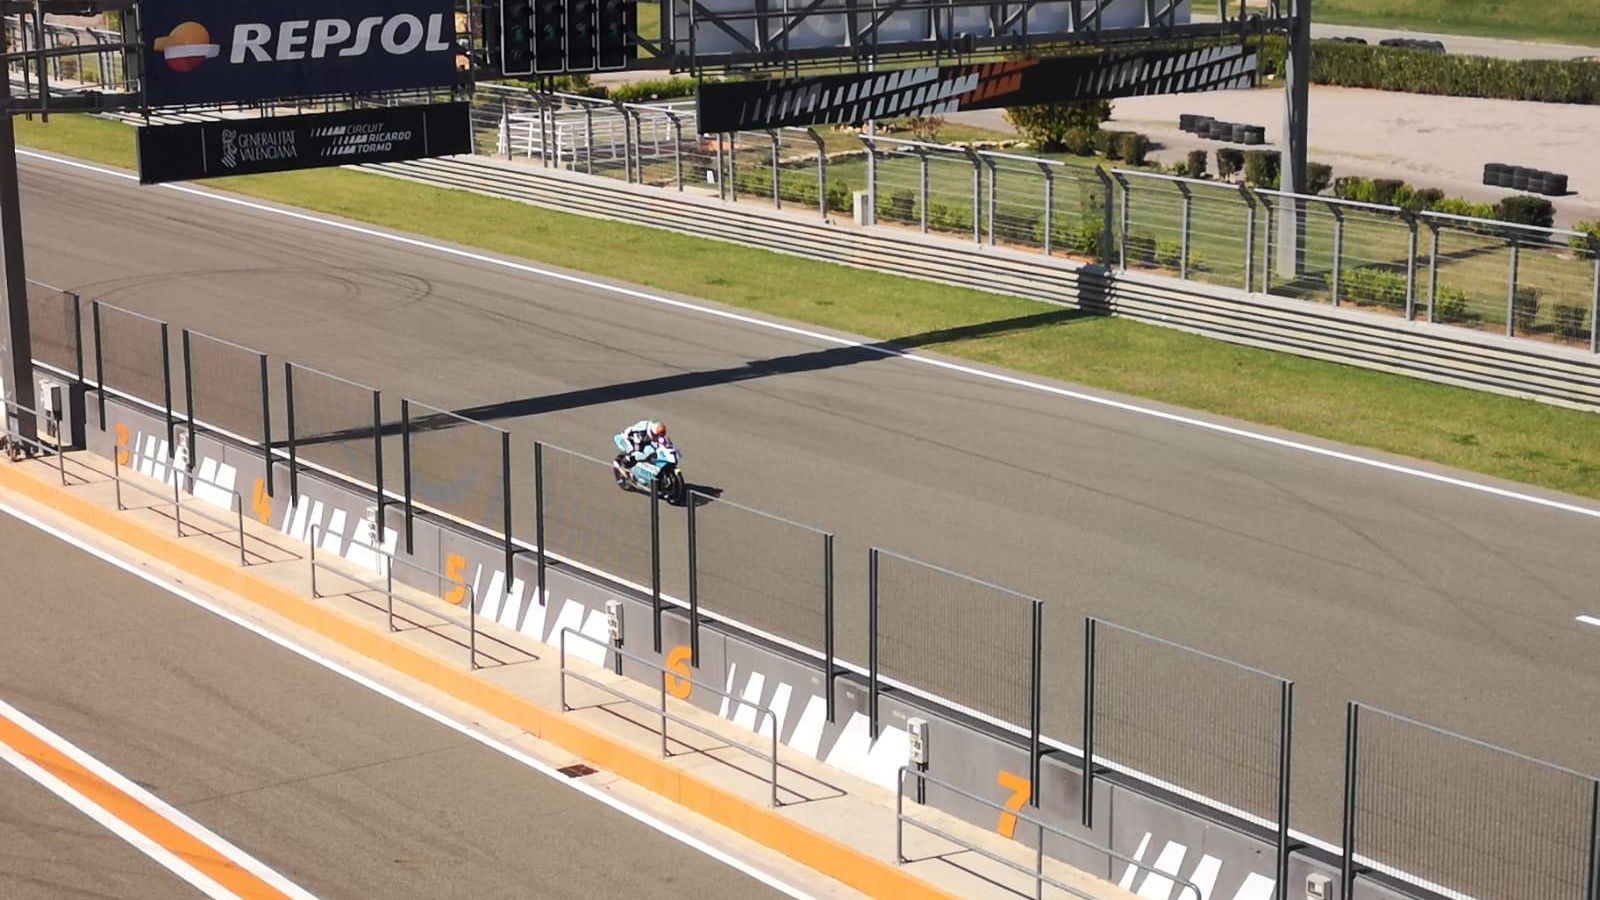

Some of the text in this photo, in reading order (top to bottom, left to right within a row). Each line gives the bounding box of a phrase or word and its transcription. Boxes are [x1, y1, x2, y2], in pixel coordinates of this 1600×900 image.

[230, 13, 449, 64] REPSOL
[238, 130, 295, 148] GENERALITAT
[347, 122, 385, 135] CIRCUIT
[369, 131, 412, 143] RICARDO
[239, 146, 298, 162] VALENCIANA
[358, 142, 392, 154] TORMO
[251, 479, 271, 527] 4
[444, 554, 467, 606] 5
[664, 645, 693, 700] 6
[997, 771, 1031, 840] 7
